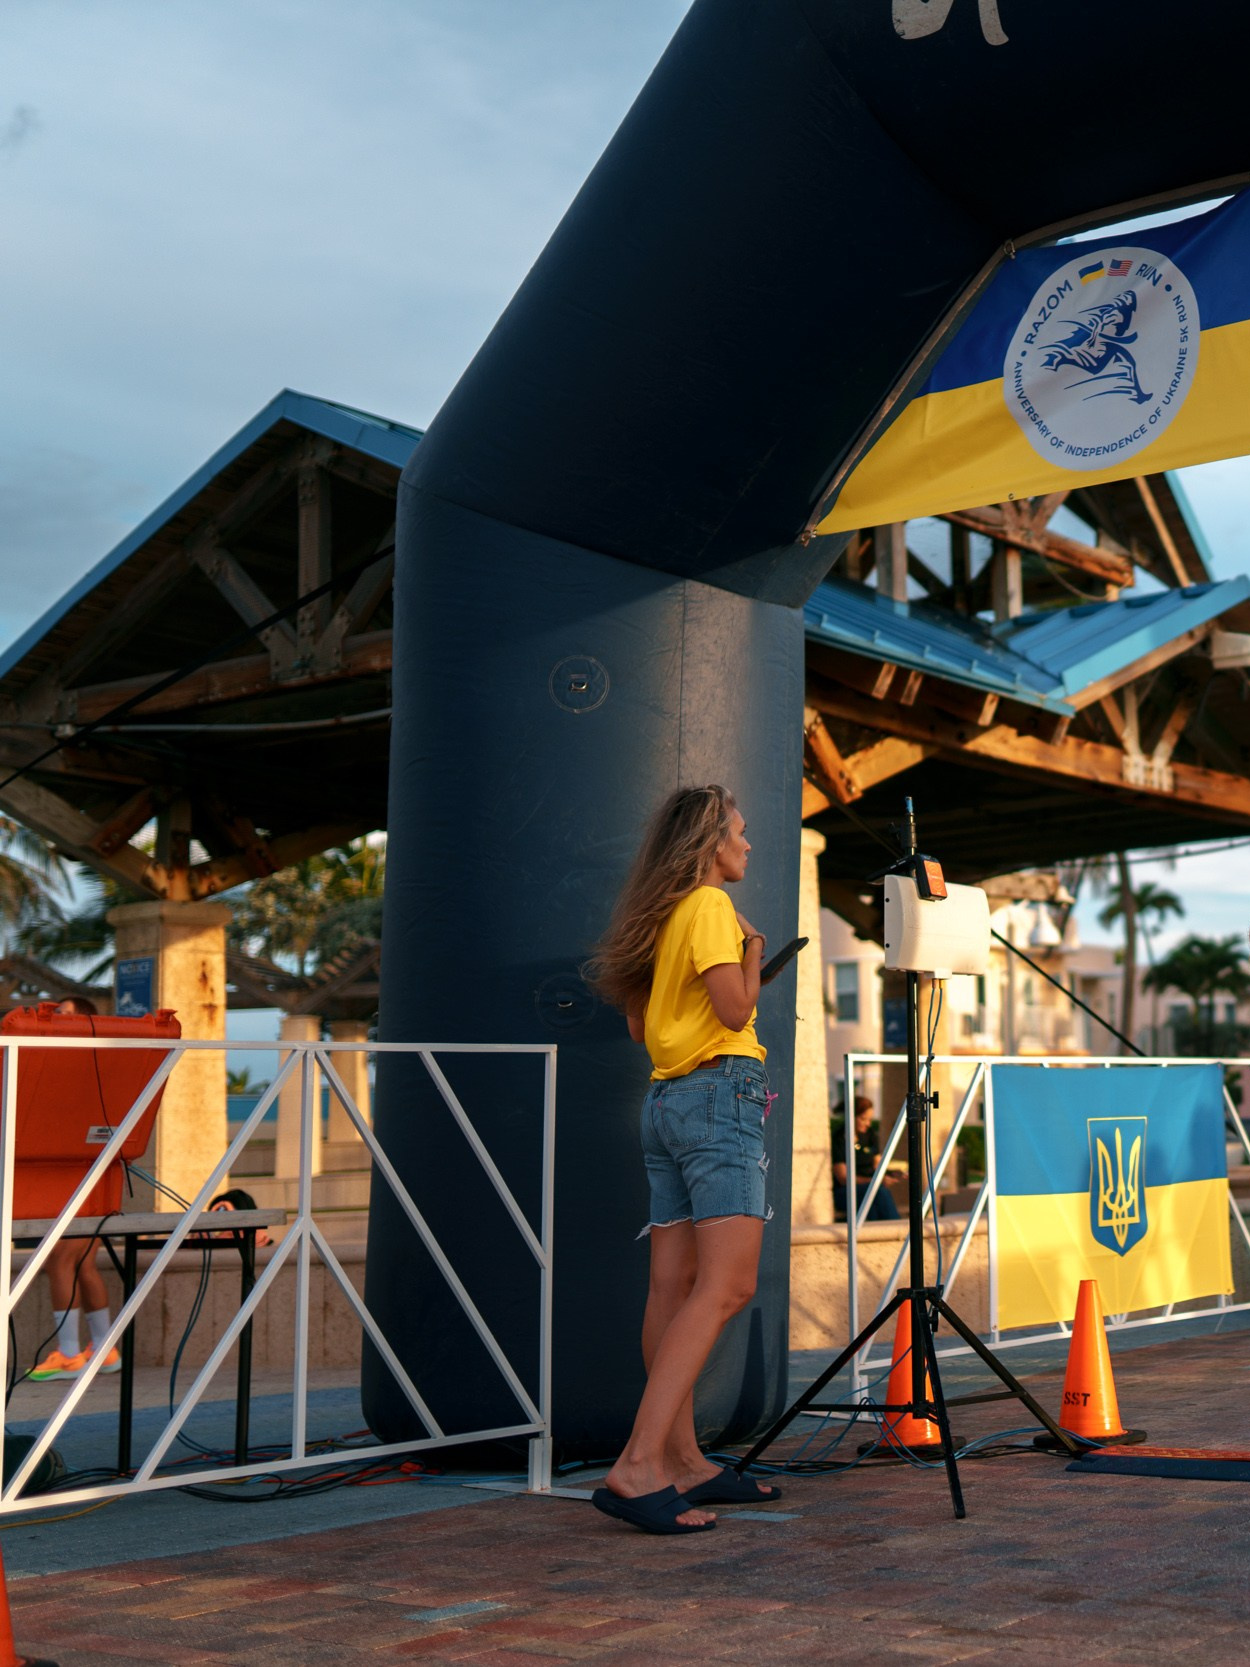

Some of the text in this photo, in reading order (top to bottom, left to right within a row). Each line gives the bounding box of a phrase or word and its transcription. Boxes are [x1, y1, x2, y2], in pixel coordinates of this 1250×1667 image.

[1024, 263, 1163, 344] RAZOM RUN
[1014, 294, 1189, 457] ANNIVERSARY OF INDEPENDENCE OF UKRAINE 5K RUN
[1063, 1391, 1091, 1407] SST
